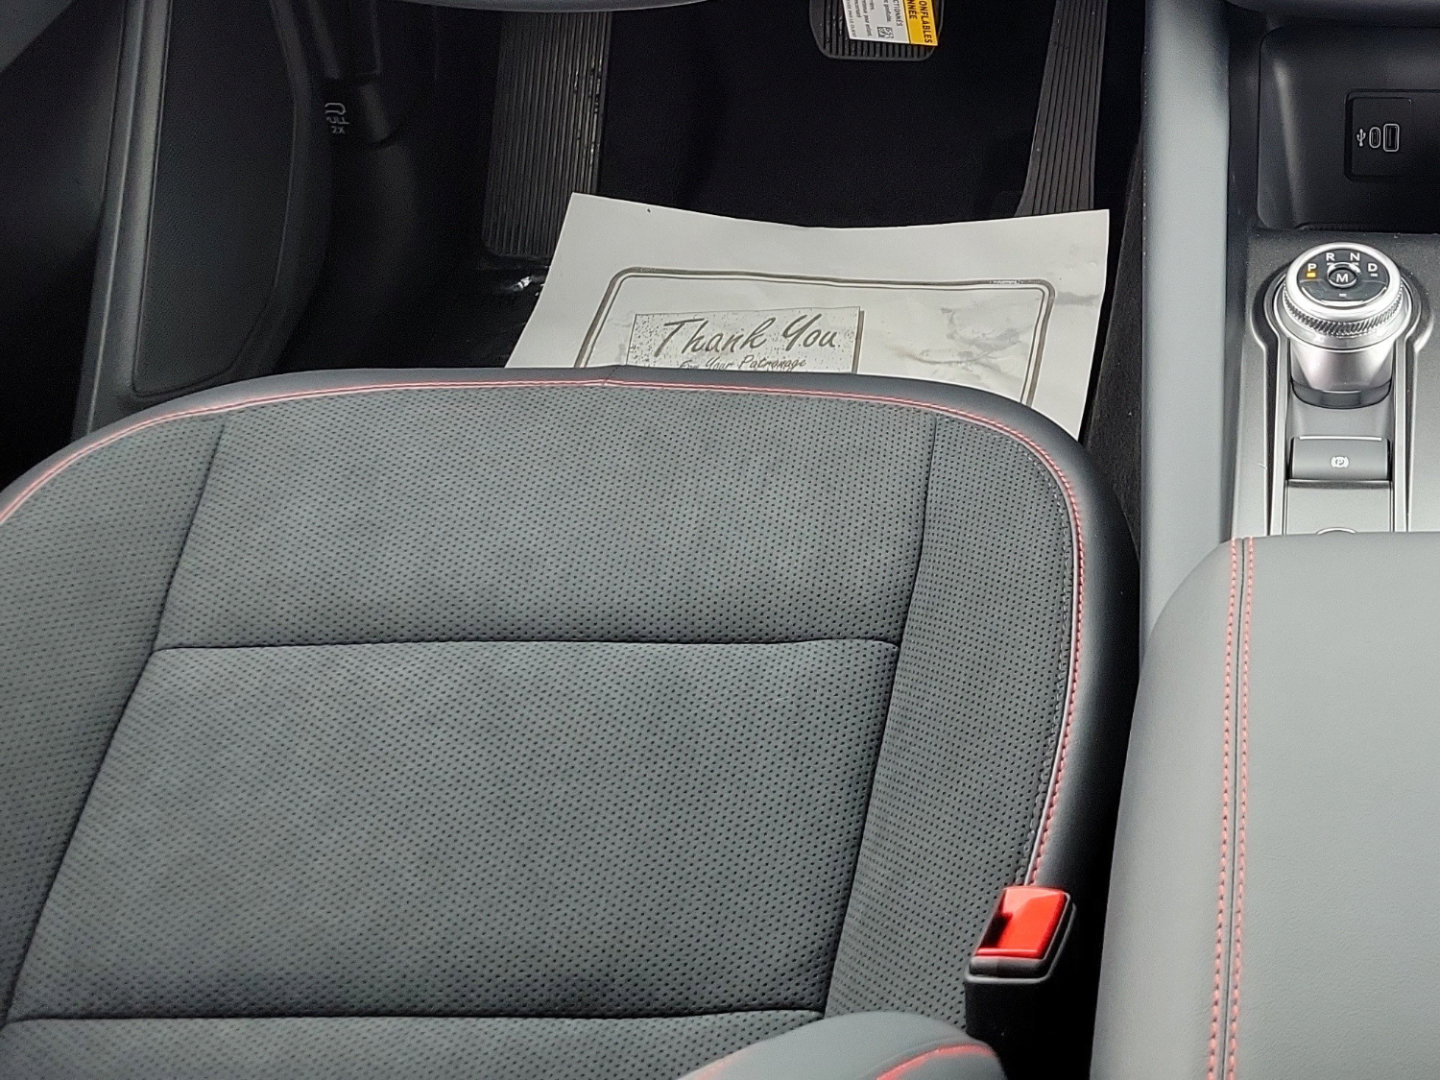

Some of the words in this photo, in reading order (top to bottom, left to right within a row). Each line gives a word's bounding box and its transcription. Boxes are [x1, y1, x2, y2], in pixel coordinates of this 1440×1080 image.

[1326, 252, 1335, 261] R
[1350, 252, 1360, 261] N
[1308, 263, 1317, 272] P
[1368, 263, 1377, 272] D
[1336, 273, 1349, 283] M
[654, 316, 776, 357] Thank
[782, 313, 838, 352] You
[738, 355, 807, 372] Patronage
